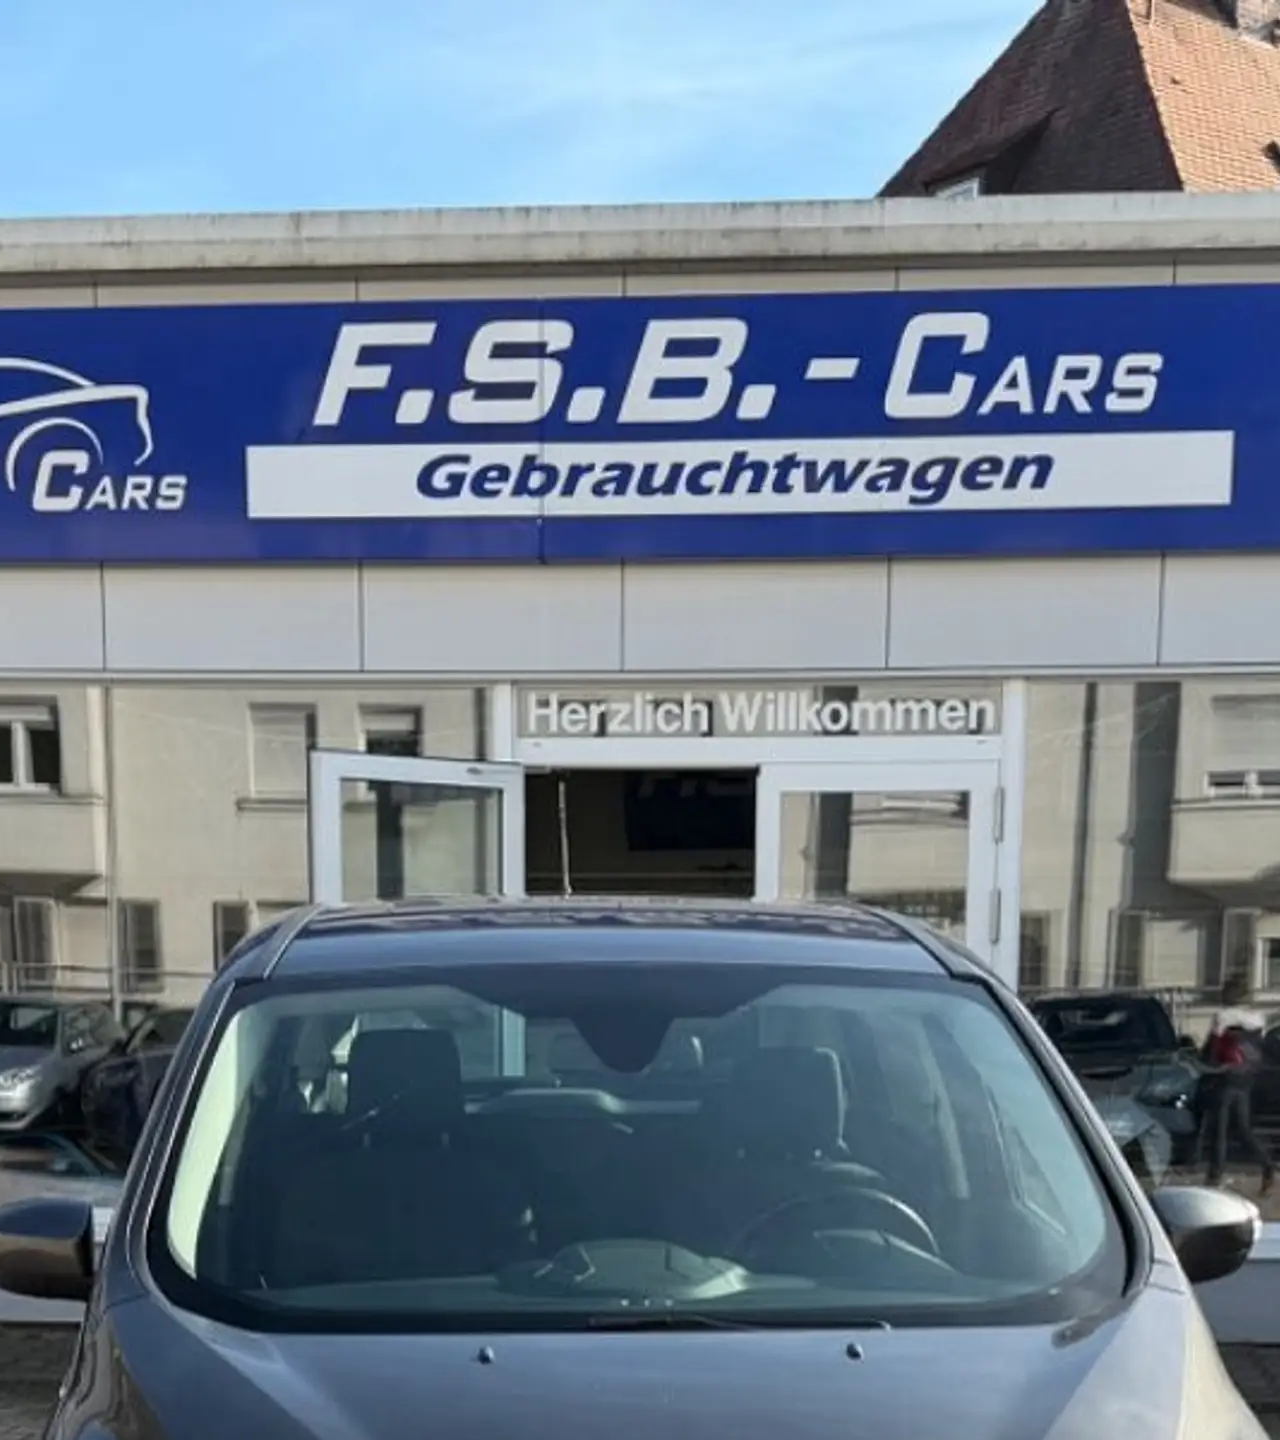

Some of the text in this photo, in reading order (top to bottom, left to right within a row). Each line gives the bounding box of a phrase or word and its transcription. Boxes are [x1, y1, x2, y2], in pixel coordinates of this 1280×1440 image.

[416, 450, 1056, 507] Gebrauchtwagen
[526, 690, 996, 734] Herzlich Willkommen
